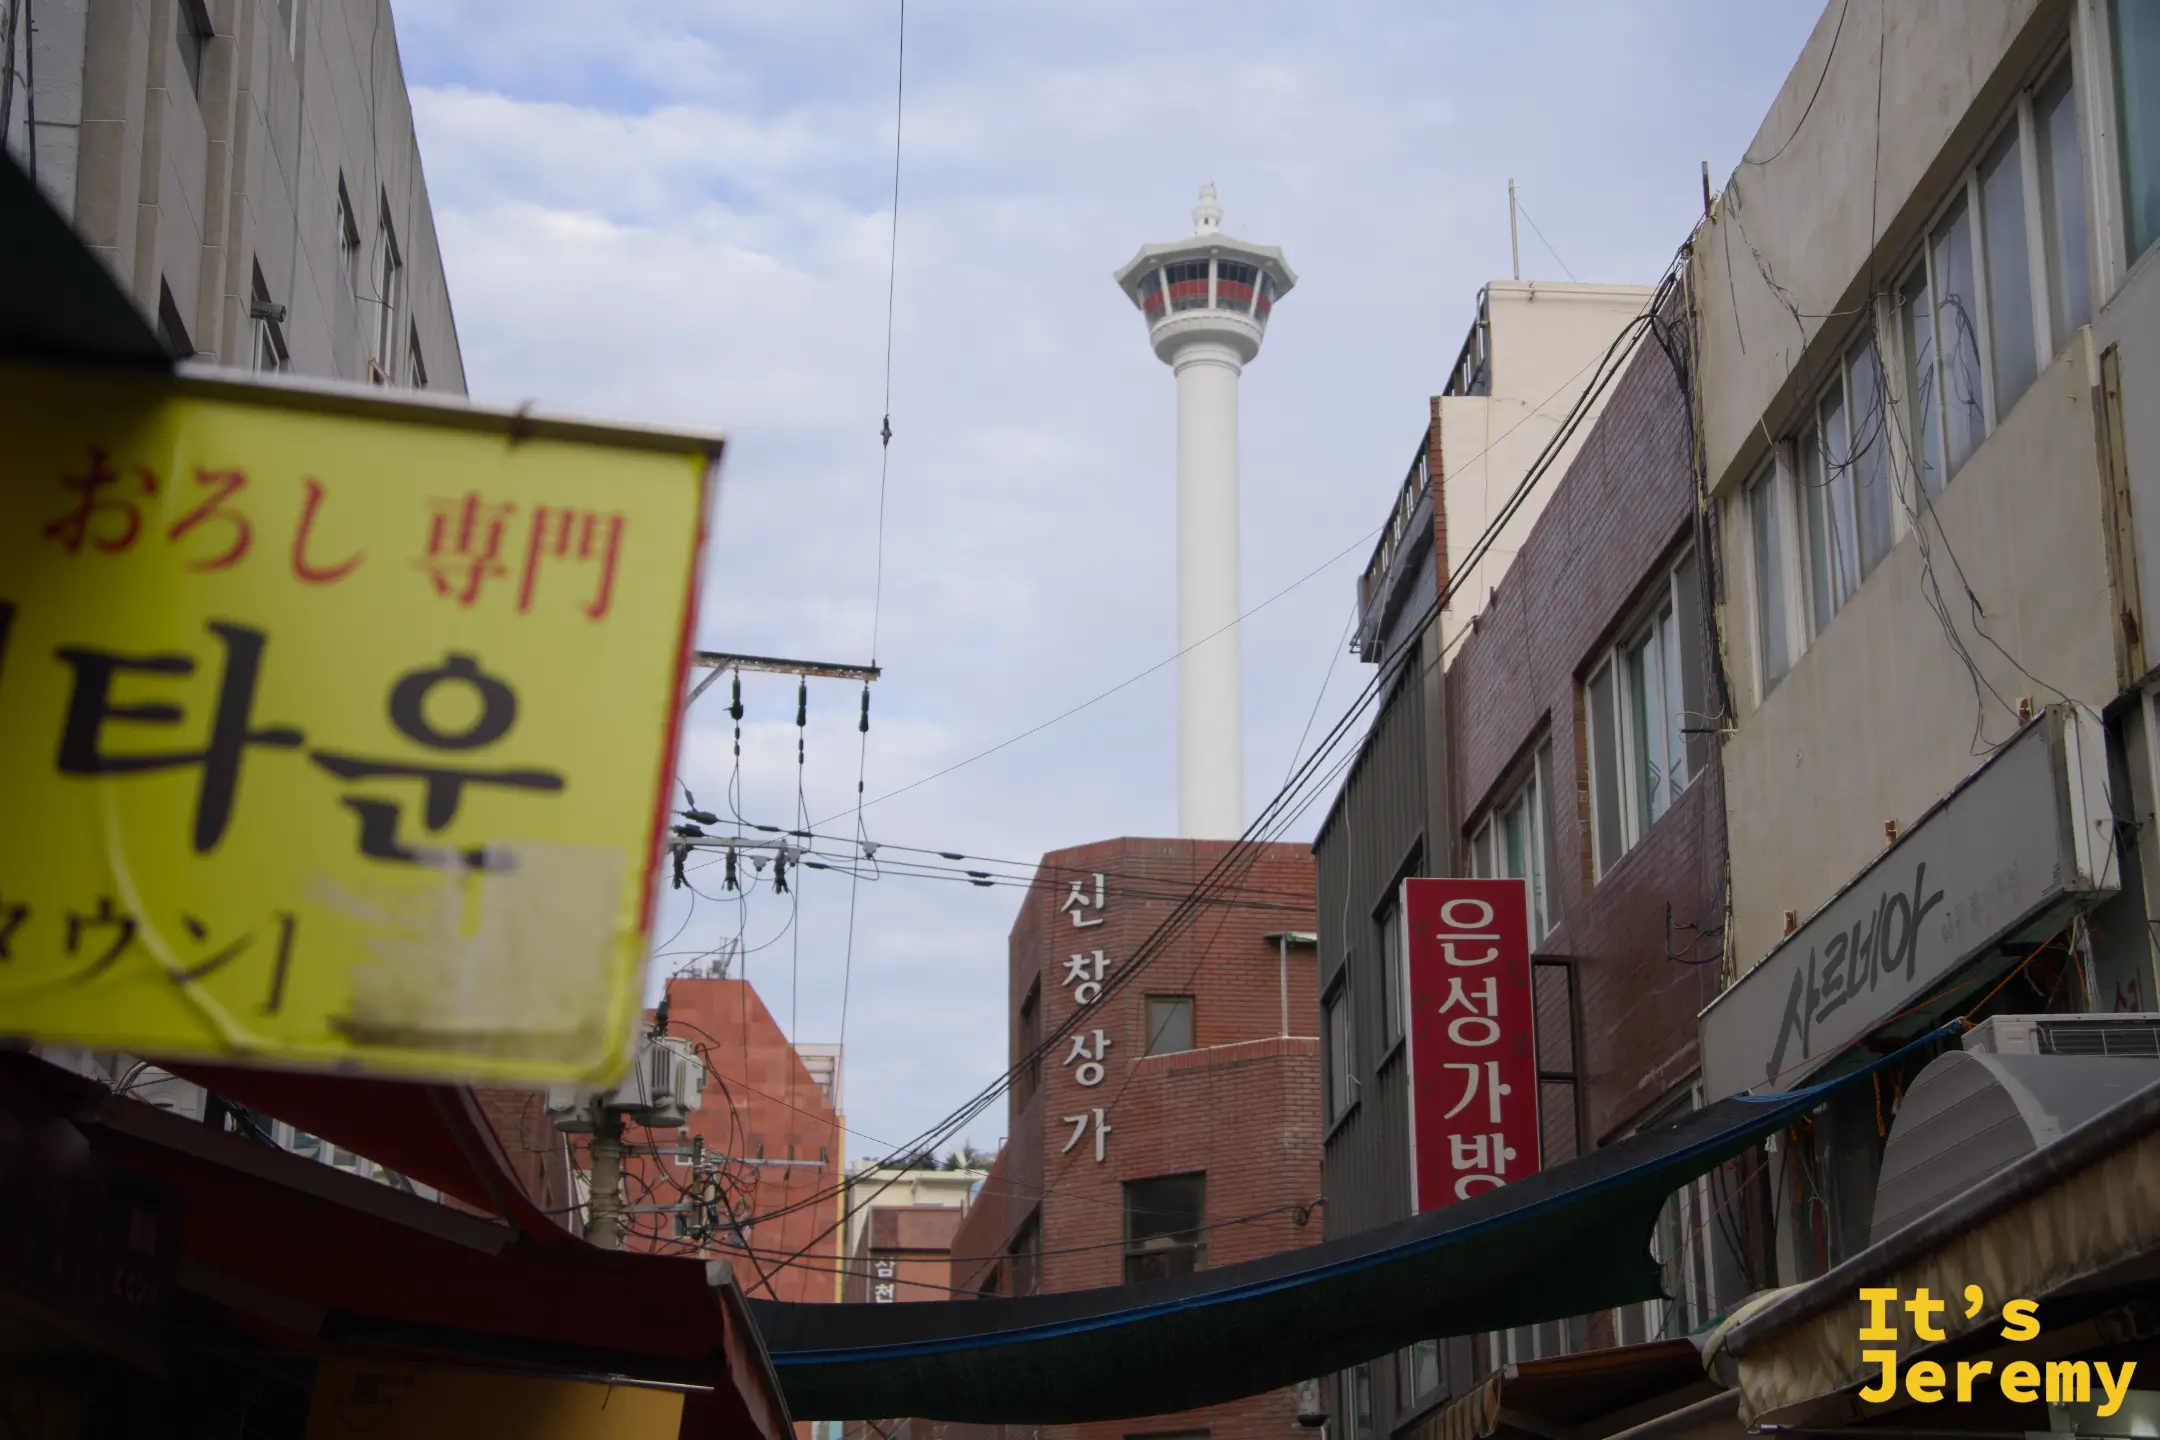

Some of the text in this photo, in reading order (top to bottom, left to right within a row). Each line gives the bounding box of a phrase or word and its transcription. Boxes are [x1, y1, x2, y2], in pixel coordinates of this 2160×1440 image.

[0, 595, 567, 872] 타운
[1060, 871, 1113, 1163] 신창상가
[1435, 898, 1517, 1201] 은성가방
